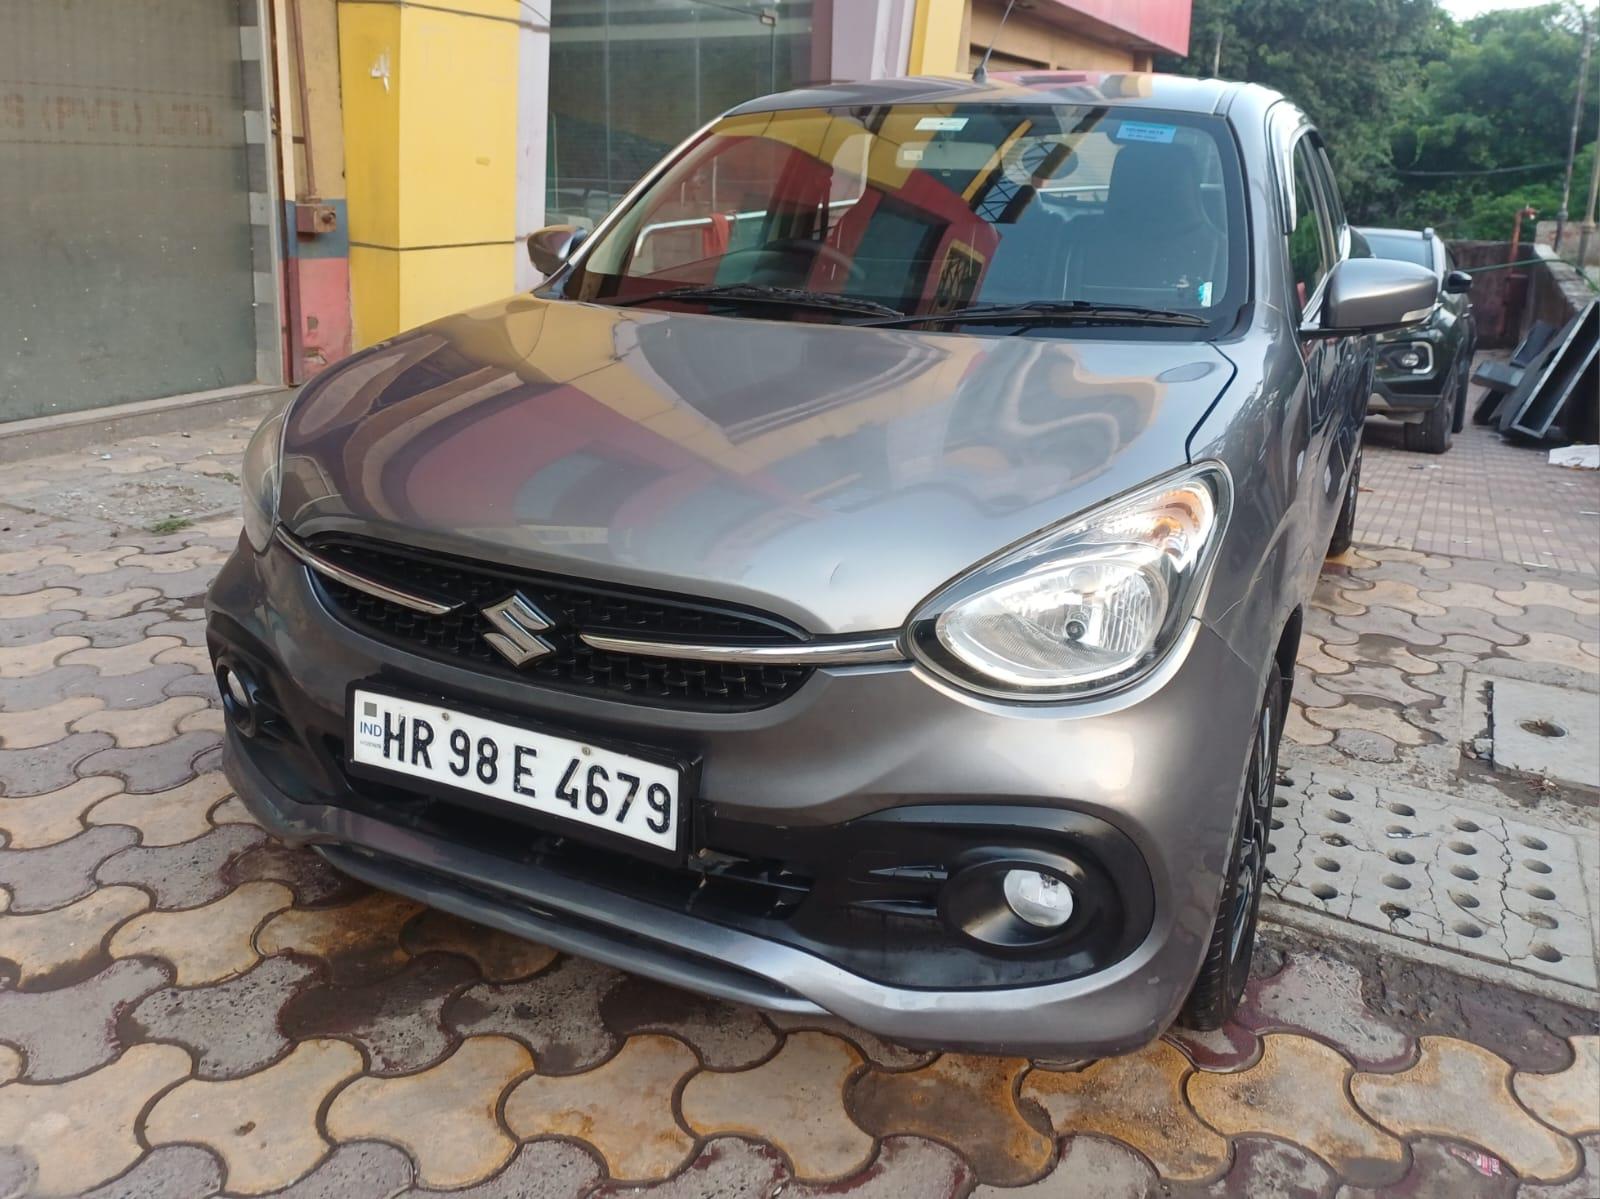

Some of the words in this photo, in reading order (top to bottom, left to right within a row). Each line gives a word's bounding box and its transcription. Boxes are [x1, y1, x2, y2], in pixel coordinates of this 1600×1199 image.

[360, 720, 383, 737] IND
[383, 711, 435, 770] HR
[448, 728, 499, 785] 98
[513, 744, 537, 798] E
[555, 758, 671, 834] 4679
